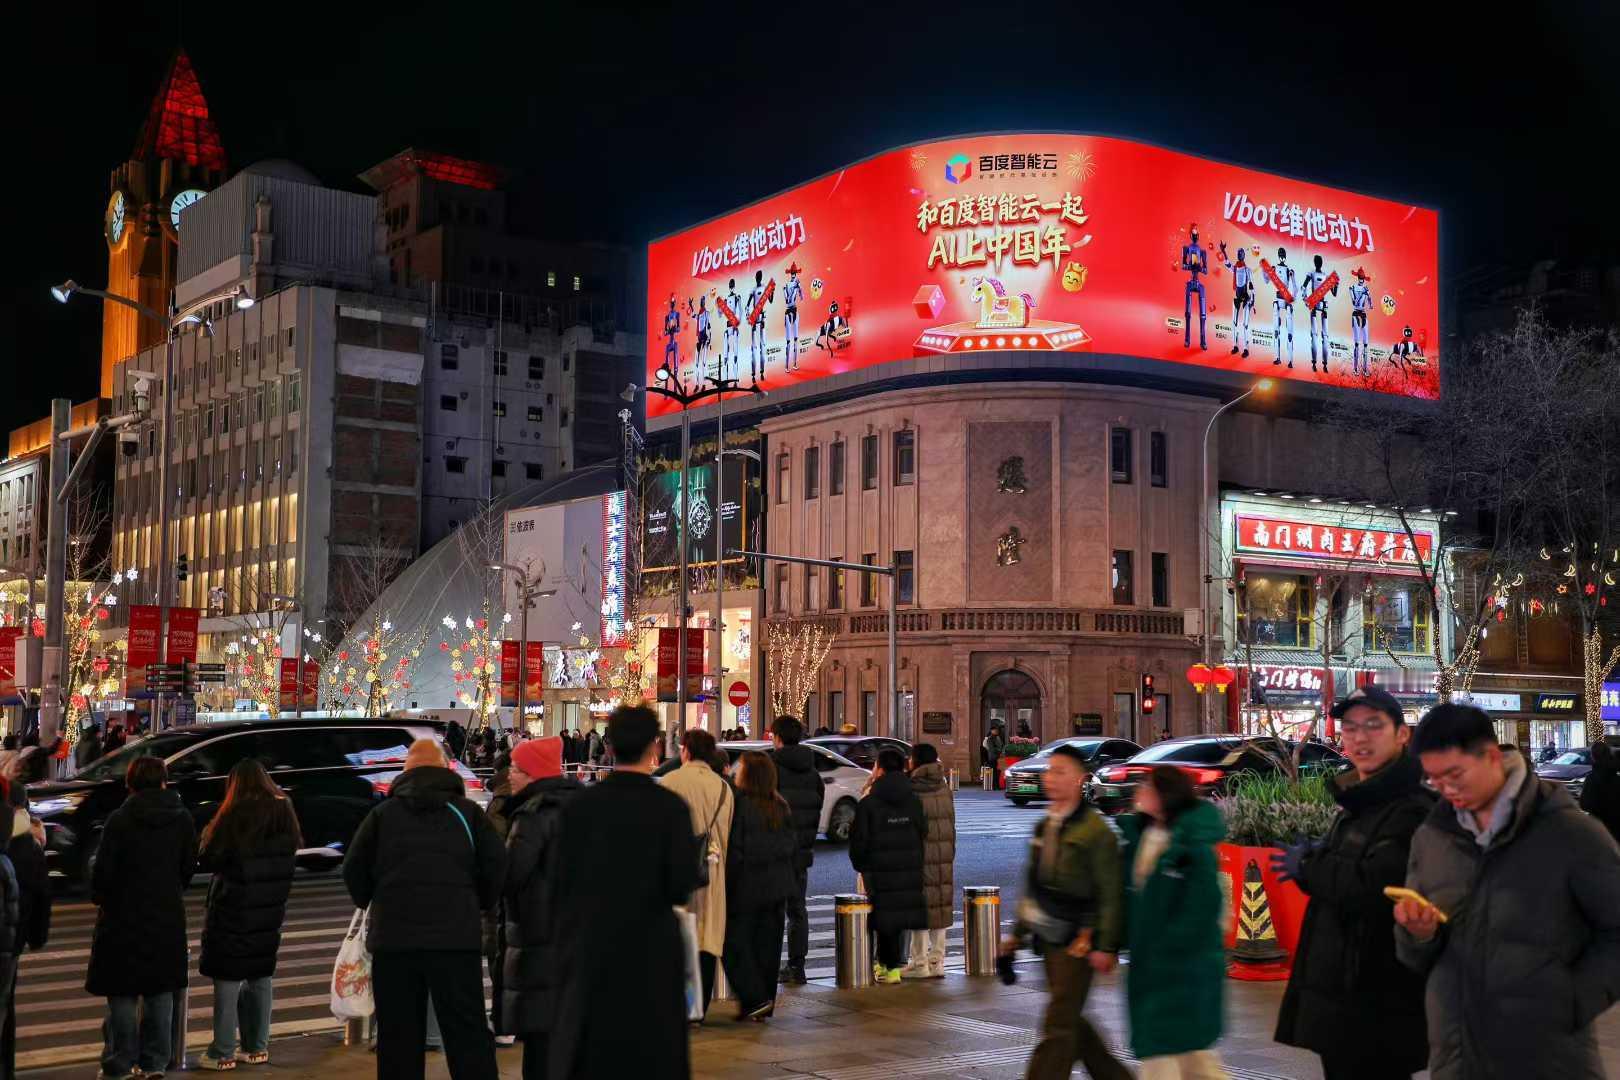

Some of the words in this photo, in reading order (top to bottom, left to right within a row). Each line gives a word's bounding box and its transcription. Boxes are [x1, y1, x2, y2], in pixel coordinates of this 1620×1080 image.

[979, 153, 1058, 171] 百度智能云
[916, 191, 1088, 233] 和百度智能云一起
[1223, 191, 1375, 252] Vbot维他动力
[692, 213, 806, 277] Vbot维他动力
[927, 224, 1072, 274] AI上中国年
